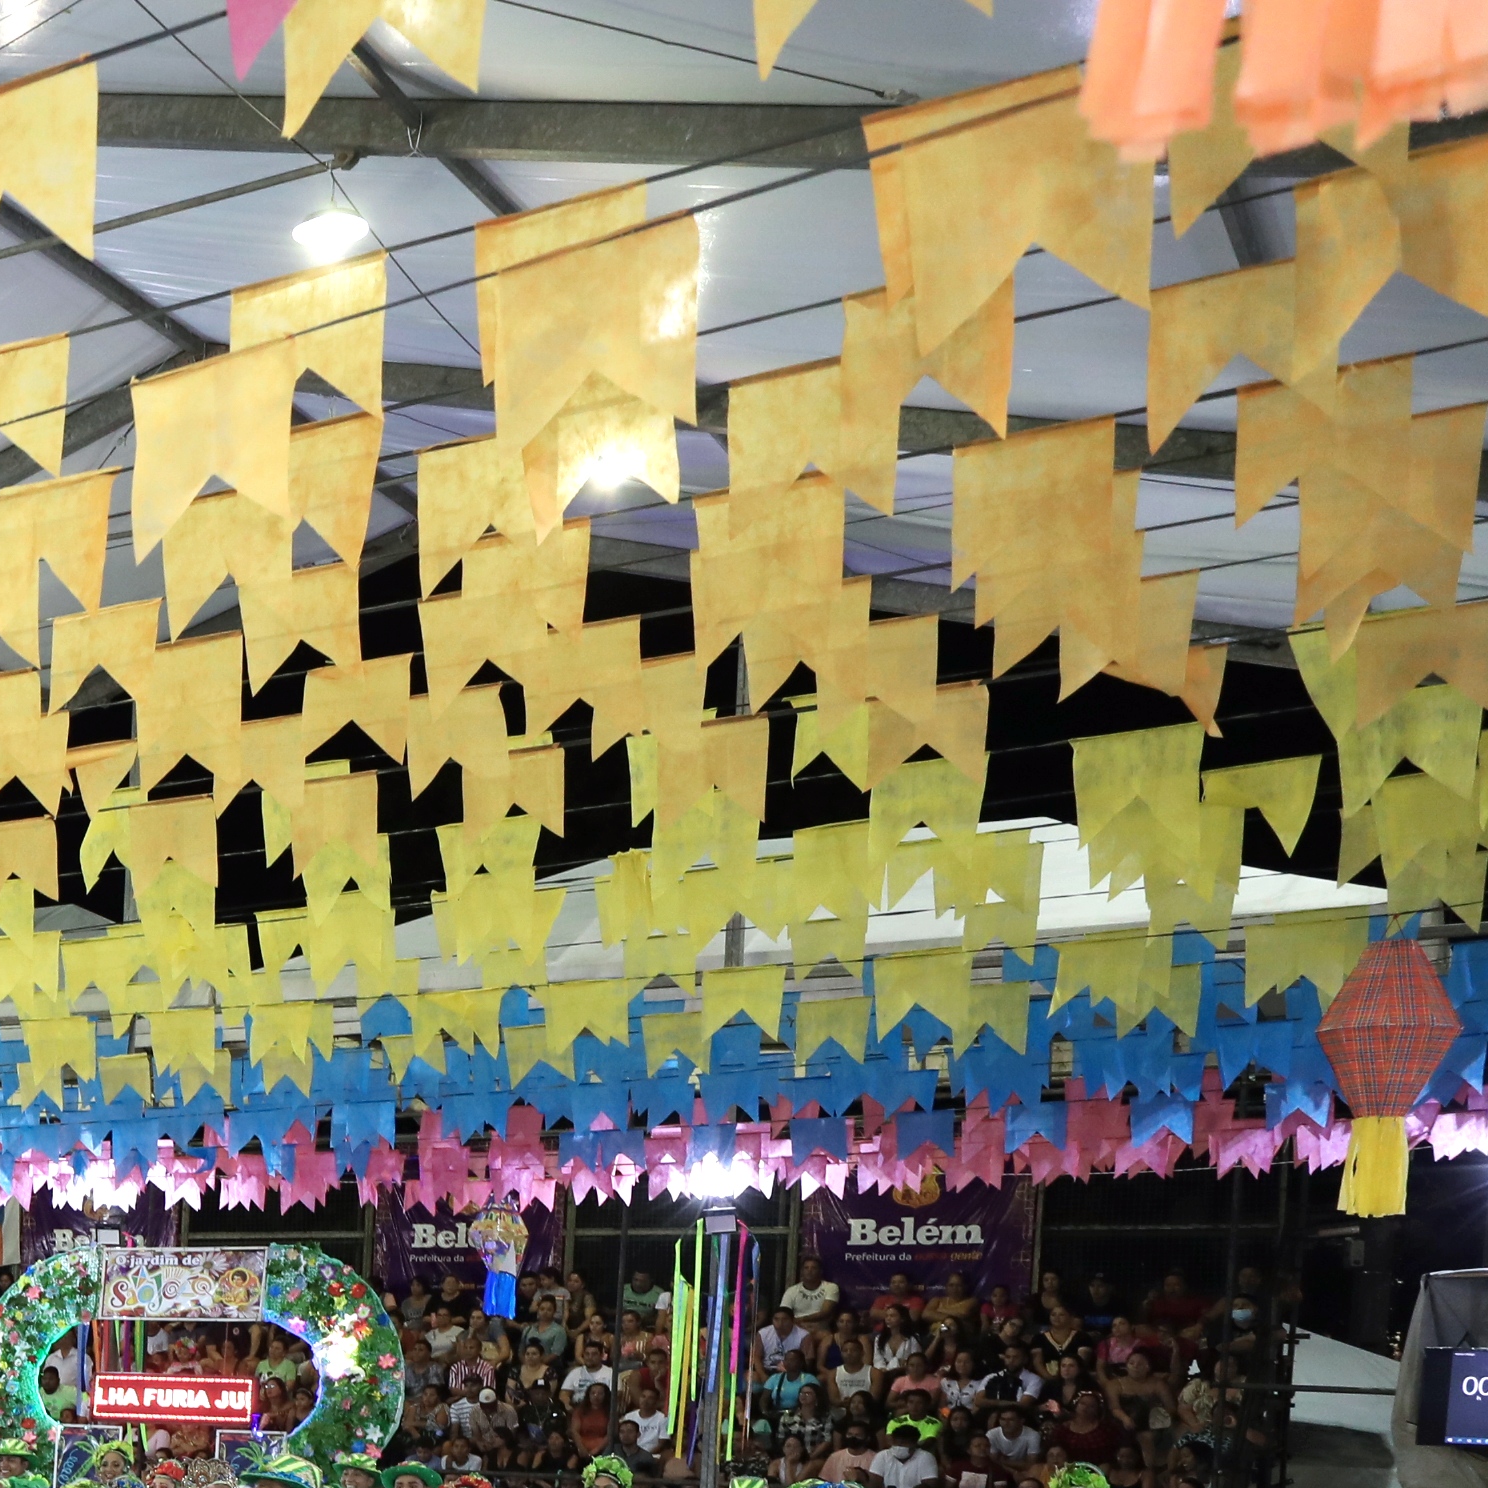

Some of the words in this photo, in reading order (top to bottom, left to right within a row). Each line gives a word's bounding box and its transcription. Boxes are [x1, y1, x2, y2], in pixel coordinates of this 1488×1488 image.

[411, 1222, 478, 1249] Bel
[846, 1216, 985, 1246] Belém
[115, 1255, 127, 1266] O
[128, 1254, 179, 1267] jardim
[181, 1255, 201, 1266] de
[409, 1254, 452, 1263] Prefeitura
[453, 1254, 465, 1263] da
[845, 1252, 896, 1262] Prefeitura
[899, 1252, 912, 1262] da
[143, 1388, 211, 1409] FURIA
